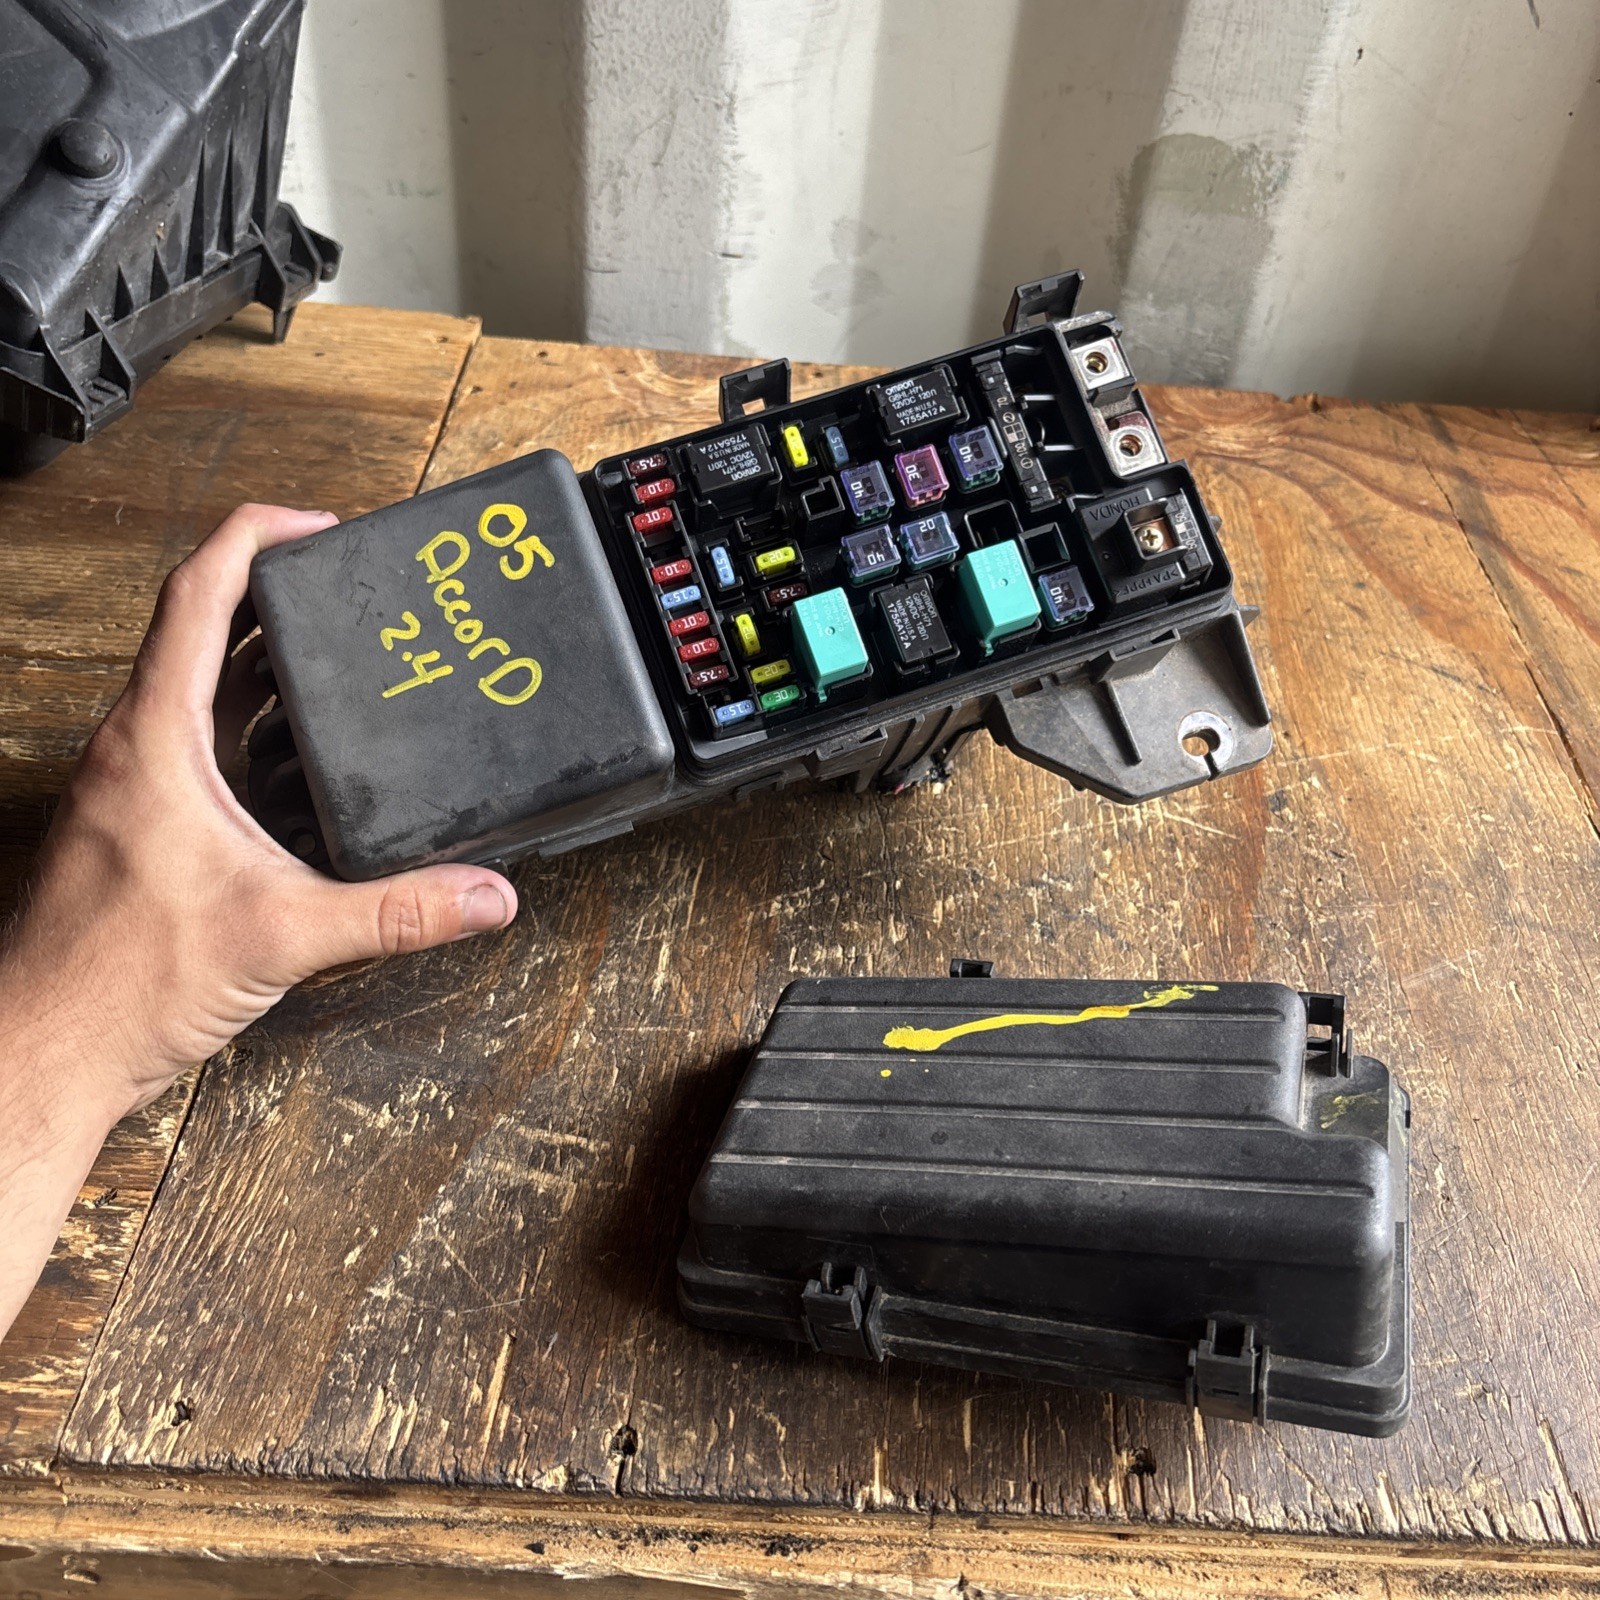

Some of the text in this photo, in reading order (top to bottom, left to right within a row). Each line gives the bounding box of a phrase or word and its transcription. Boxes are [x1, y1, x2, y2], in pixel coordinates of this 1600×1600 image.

[892, 396, 917, 410] 12VDC
[896, 407, 915, 418] MADE
[831, 435, 844, 450] 15
[959, 446, 973, 463] 40
[639, 457, 658, 470] 7.5
[905, 464, 920, 481] 30
[647, 482, 663, 495] 10
[851, 481, 864, 498] 40
[1089, 496, 1141, 521] HONDA
[645, 511, 661, 523] 10
[918, 519, 936, 533] 20
[478, 503, 555, 580] 05
[768, 551, 783, 564] 20
[867, 552, 885, 566] 40
[664, 563, 680, 576] 10
[717, 557, 729, 574] 15
[673, 588, 687, 599] 15
[779, 588, 798, 600] 7.5
[1050, 586, 1064, 604] 40
[905, 596, 920, 620] 12VDC
[682, 616, 697, 630] 10
[380, 611, 454, 699] 2.4
[691, 642, 706, 654] 10
[699, 669, 718, 683] 7.5
[763, 664, 779, 677] 20
[774, 690, 788, 702] 30
[729, 704, 743, 717] 15
